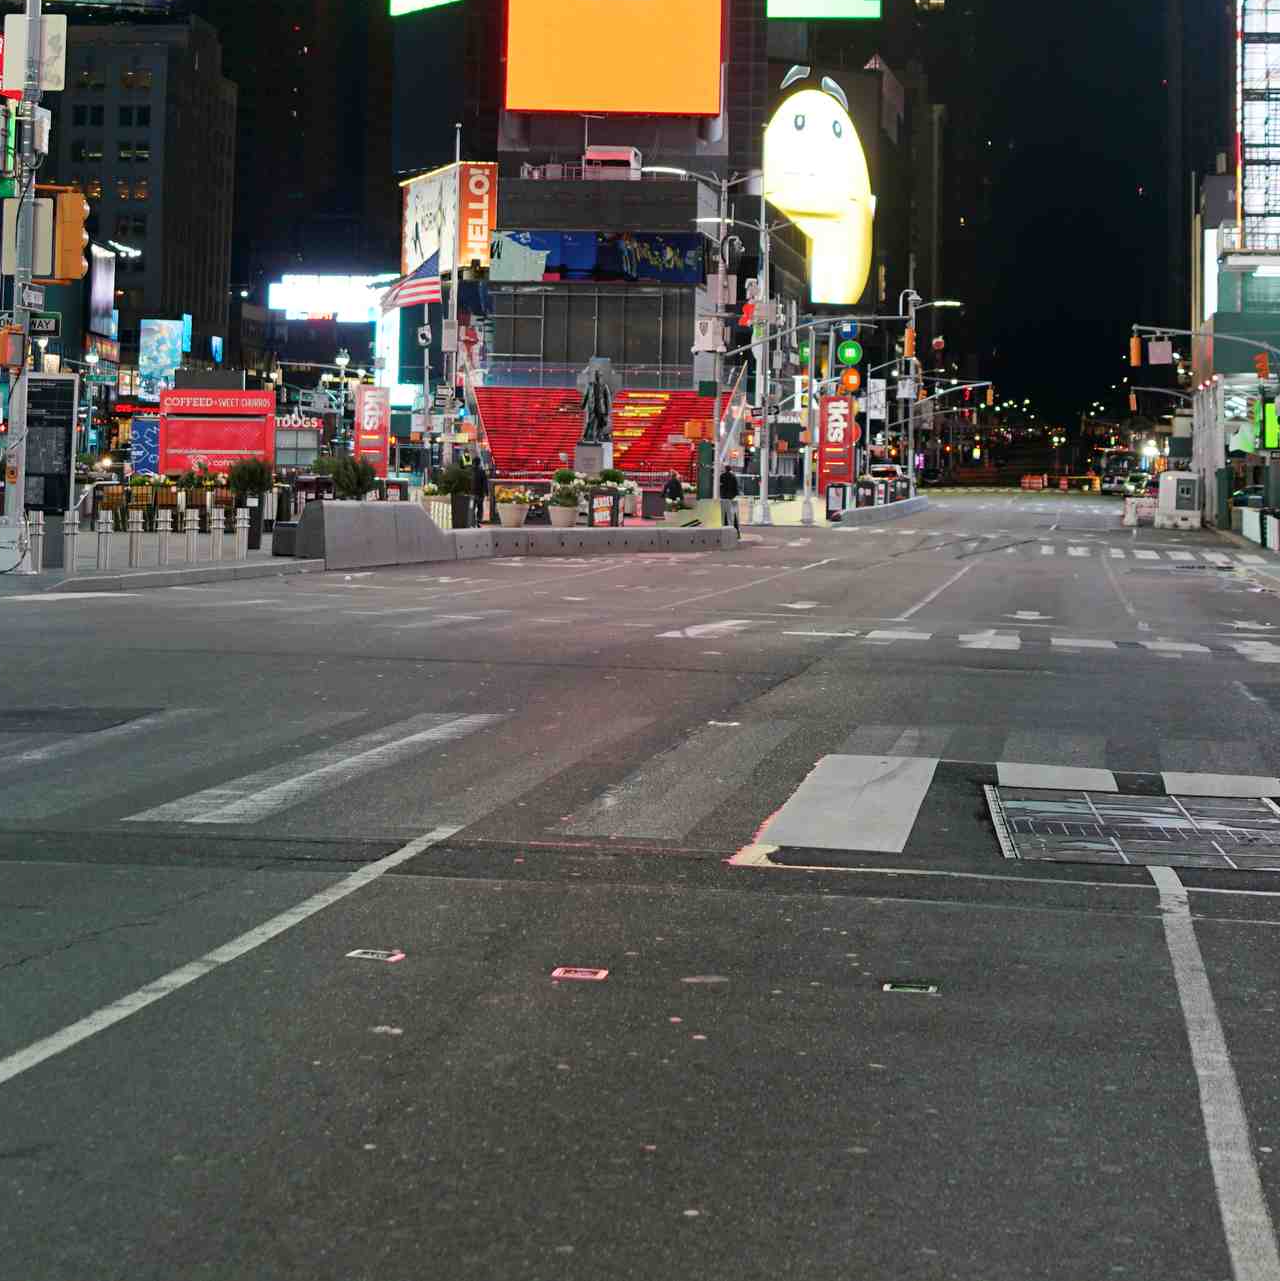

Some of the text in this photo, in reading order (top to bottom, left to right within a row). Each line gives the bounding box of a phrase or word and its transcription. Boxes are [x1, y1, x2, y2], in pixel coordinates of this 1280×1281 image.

[467, 166, 490, 262] HELLO!
[164, 396, 213, 408] COFFEED
[827, 400, 849, 443] tkts
